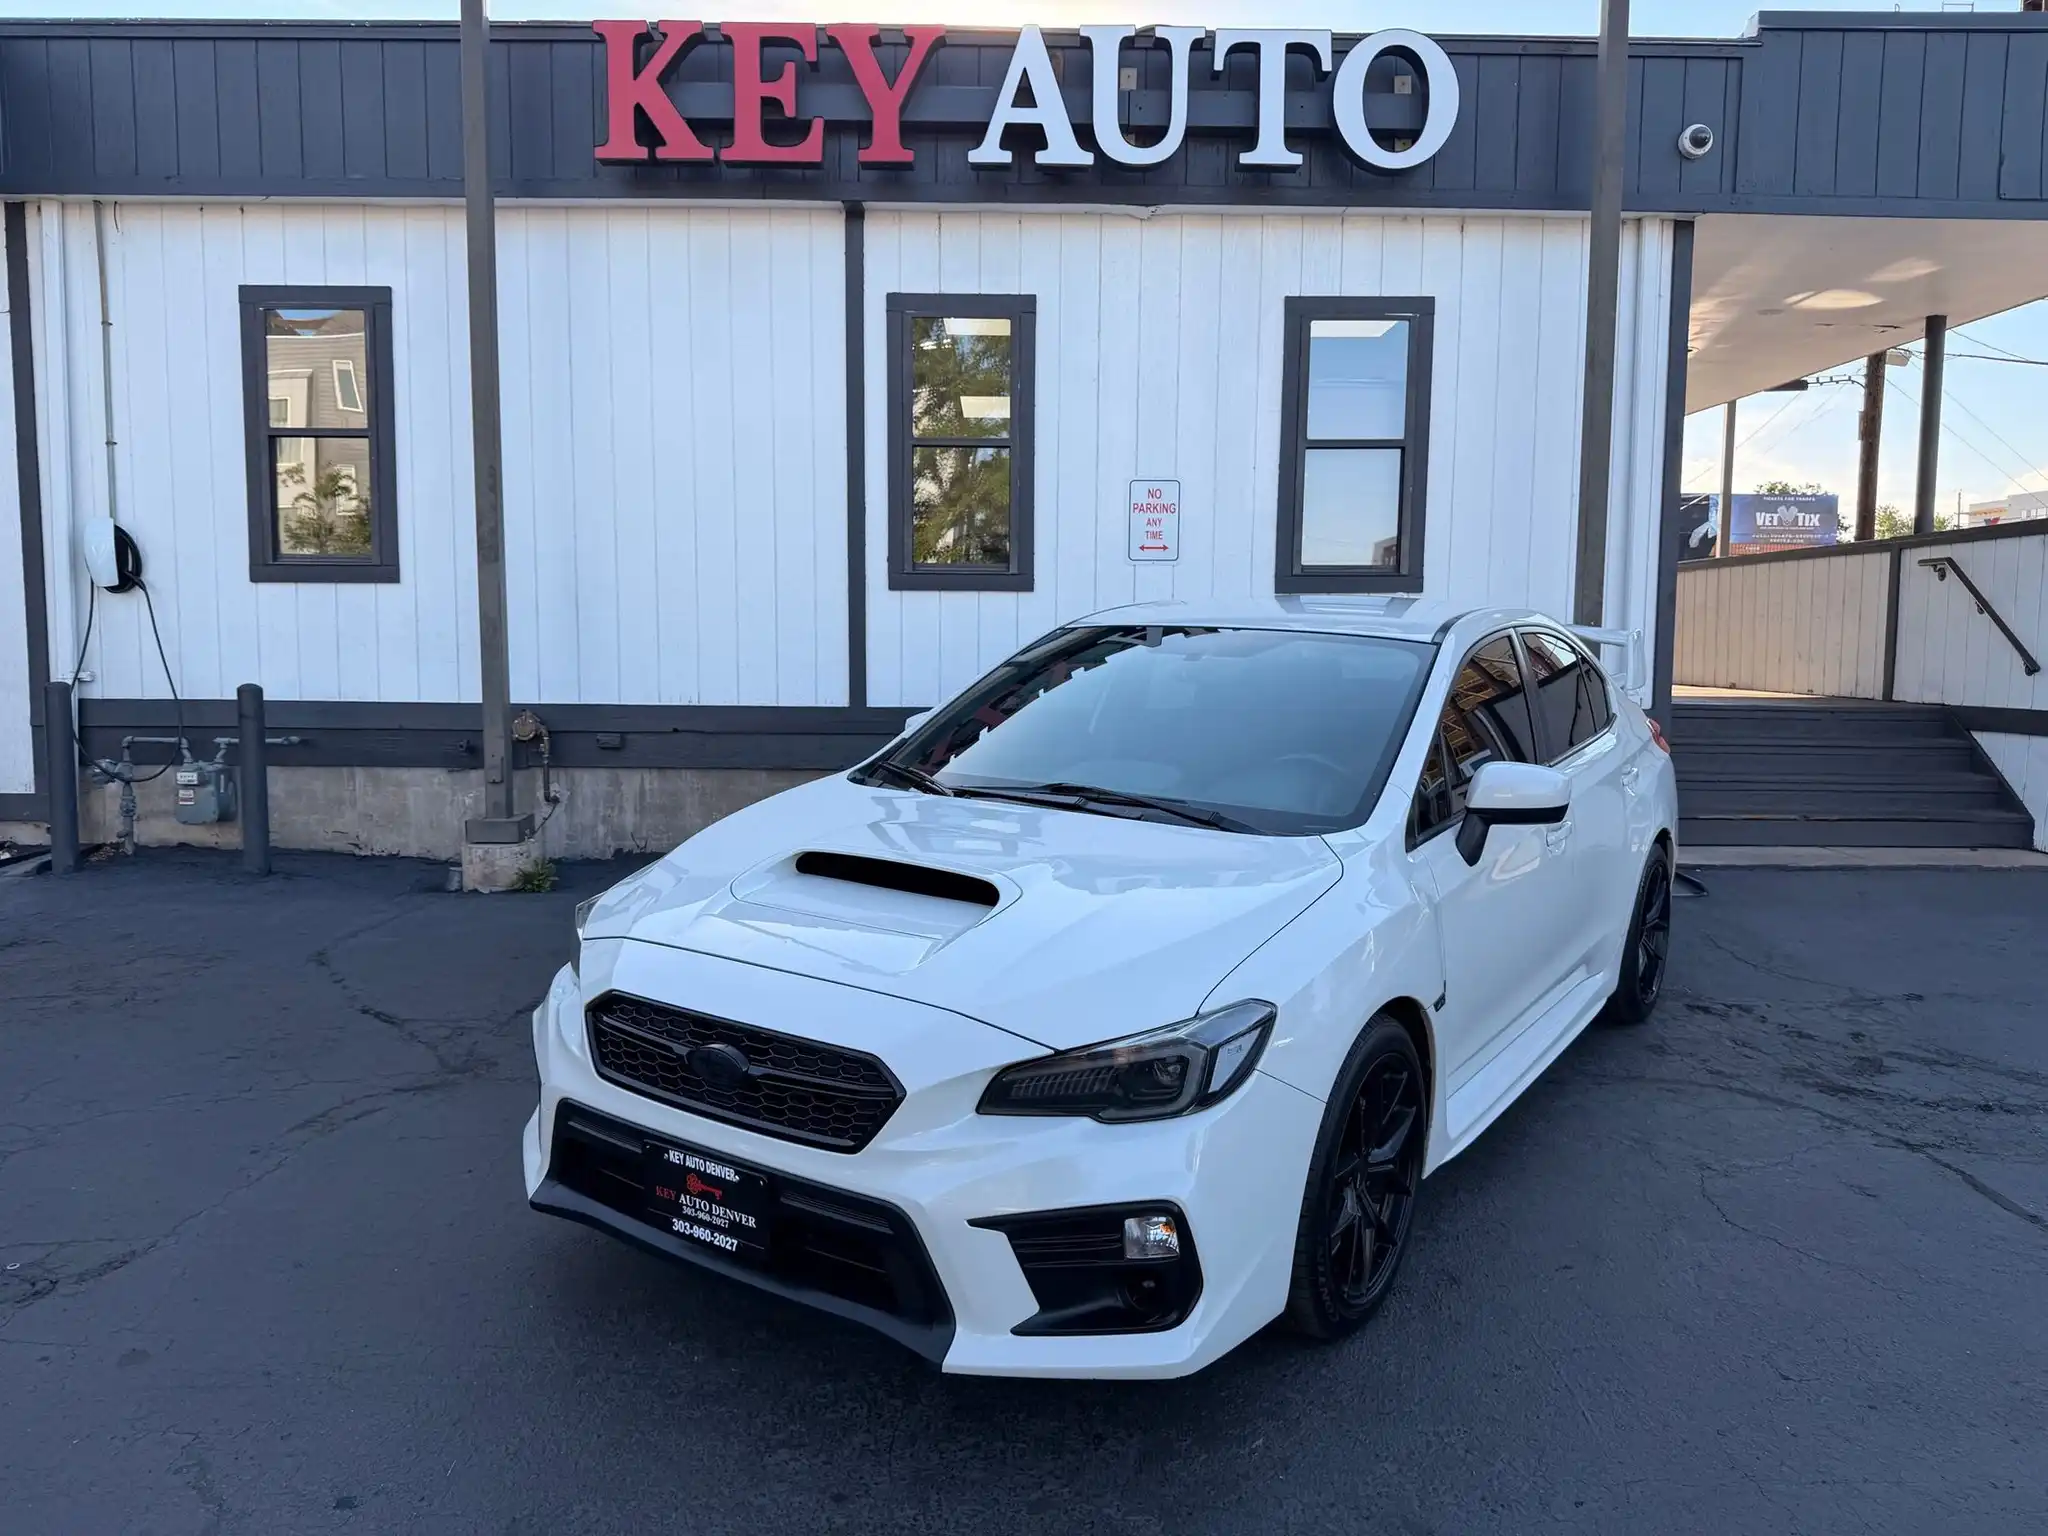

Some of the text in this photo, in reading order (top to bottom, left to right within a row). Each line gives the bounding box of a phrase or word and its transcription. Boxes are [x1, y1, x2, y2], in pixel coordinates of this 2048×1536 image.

[592, 19, 1460, 172] KEY AUTO
[1147, 488, 1162, 499] NO
[1132, 503, 1176, 514] PARKING
[1146, 518, 1162, 527] ANY
[1755, 512, 1821, 527] VET TIX
[1145, 531, 1163, 540] TIME
[668, 1149, 736, 1182] KEY AUTO DENVER
[656, 1185, 757, 1229] KEY AUTO DENVER
[682, 1206, 729, 1229] 303-960-2027
[672, 1218, 738, 1252] 303-960-2027
